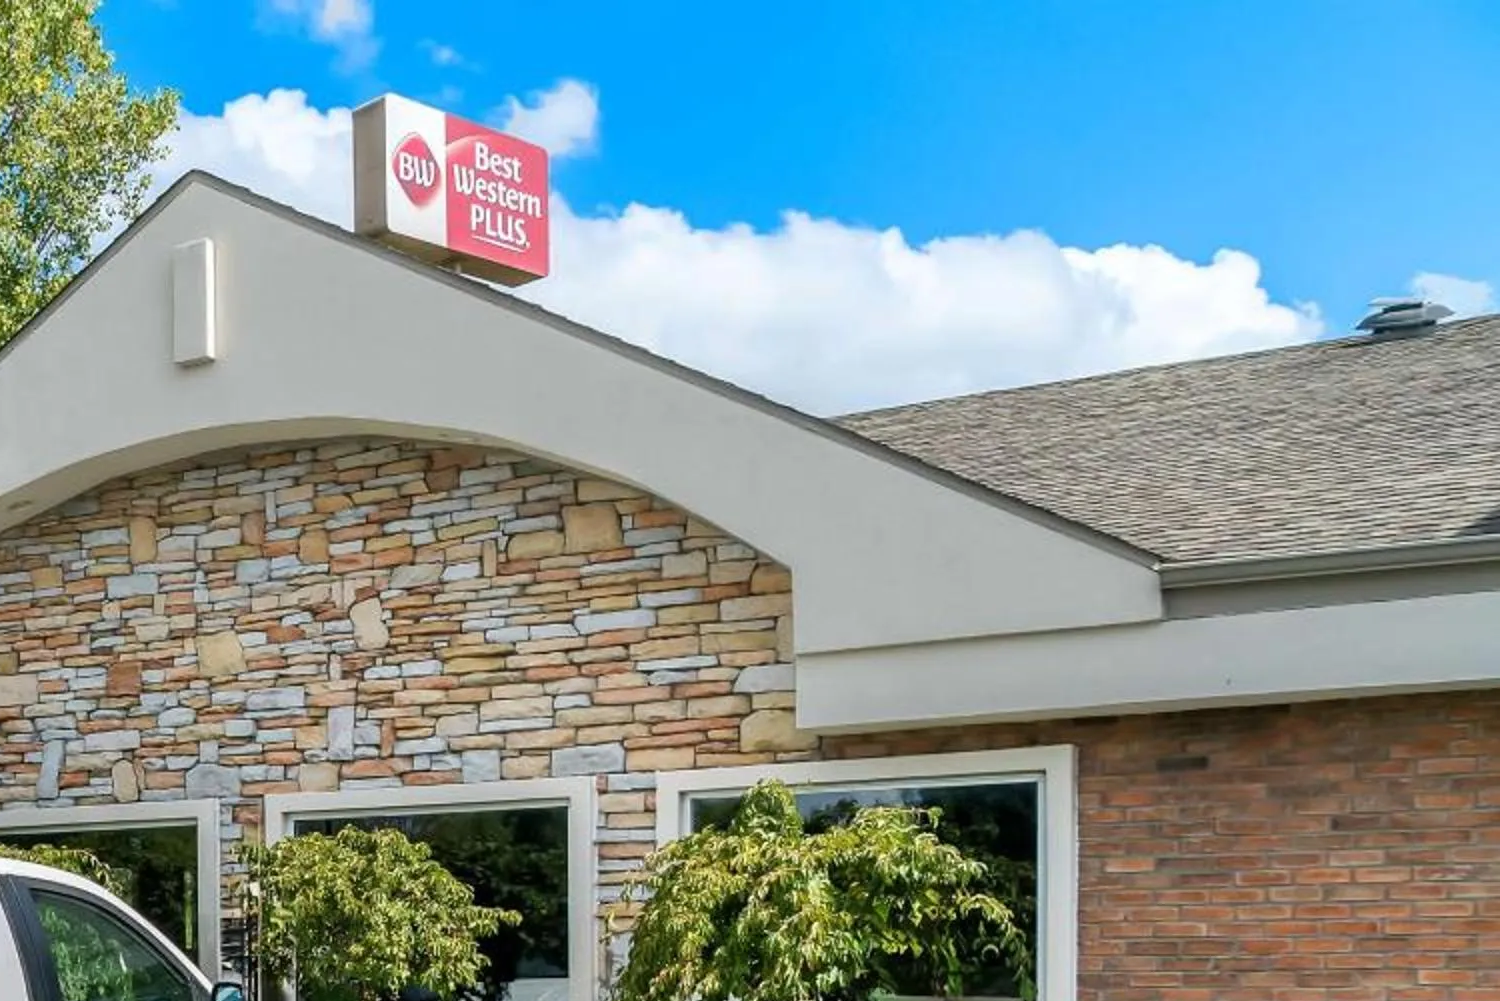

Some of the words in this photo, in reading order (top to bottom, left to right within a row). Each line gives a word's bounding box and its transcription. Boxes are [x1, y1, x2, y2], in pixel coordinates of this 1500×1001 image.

[399, 152, 435, 187] BW
[475, 141, 522, 184] Best
[453, 164, 541, 218] Western
[470, 204, 526, 246] PLUS
